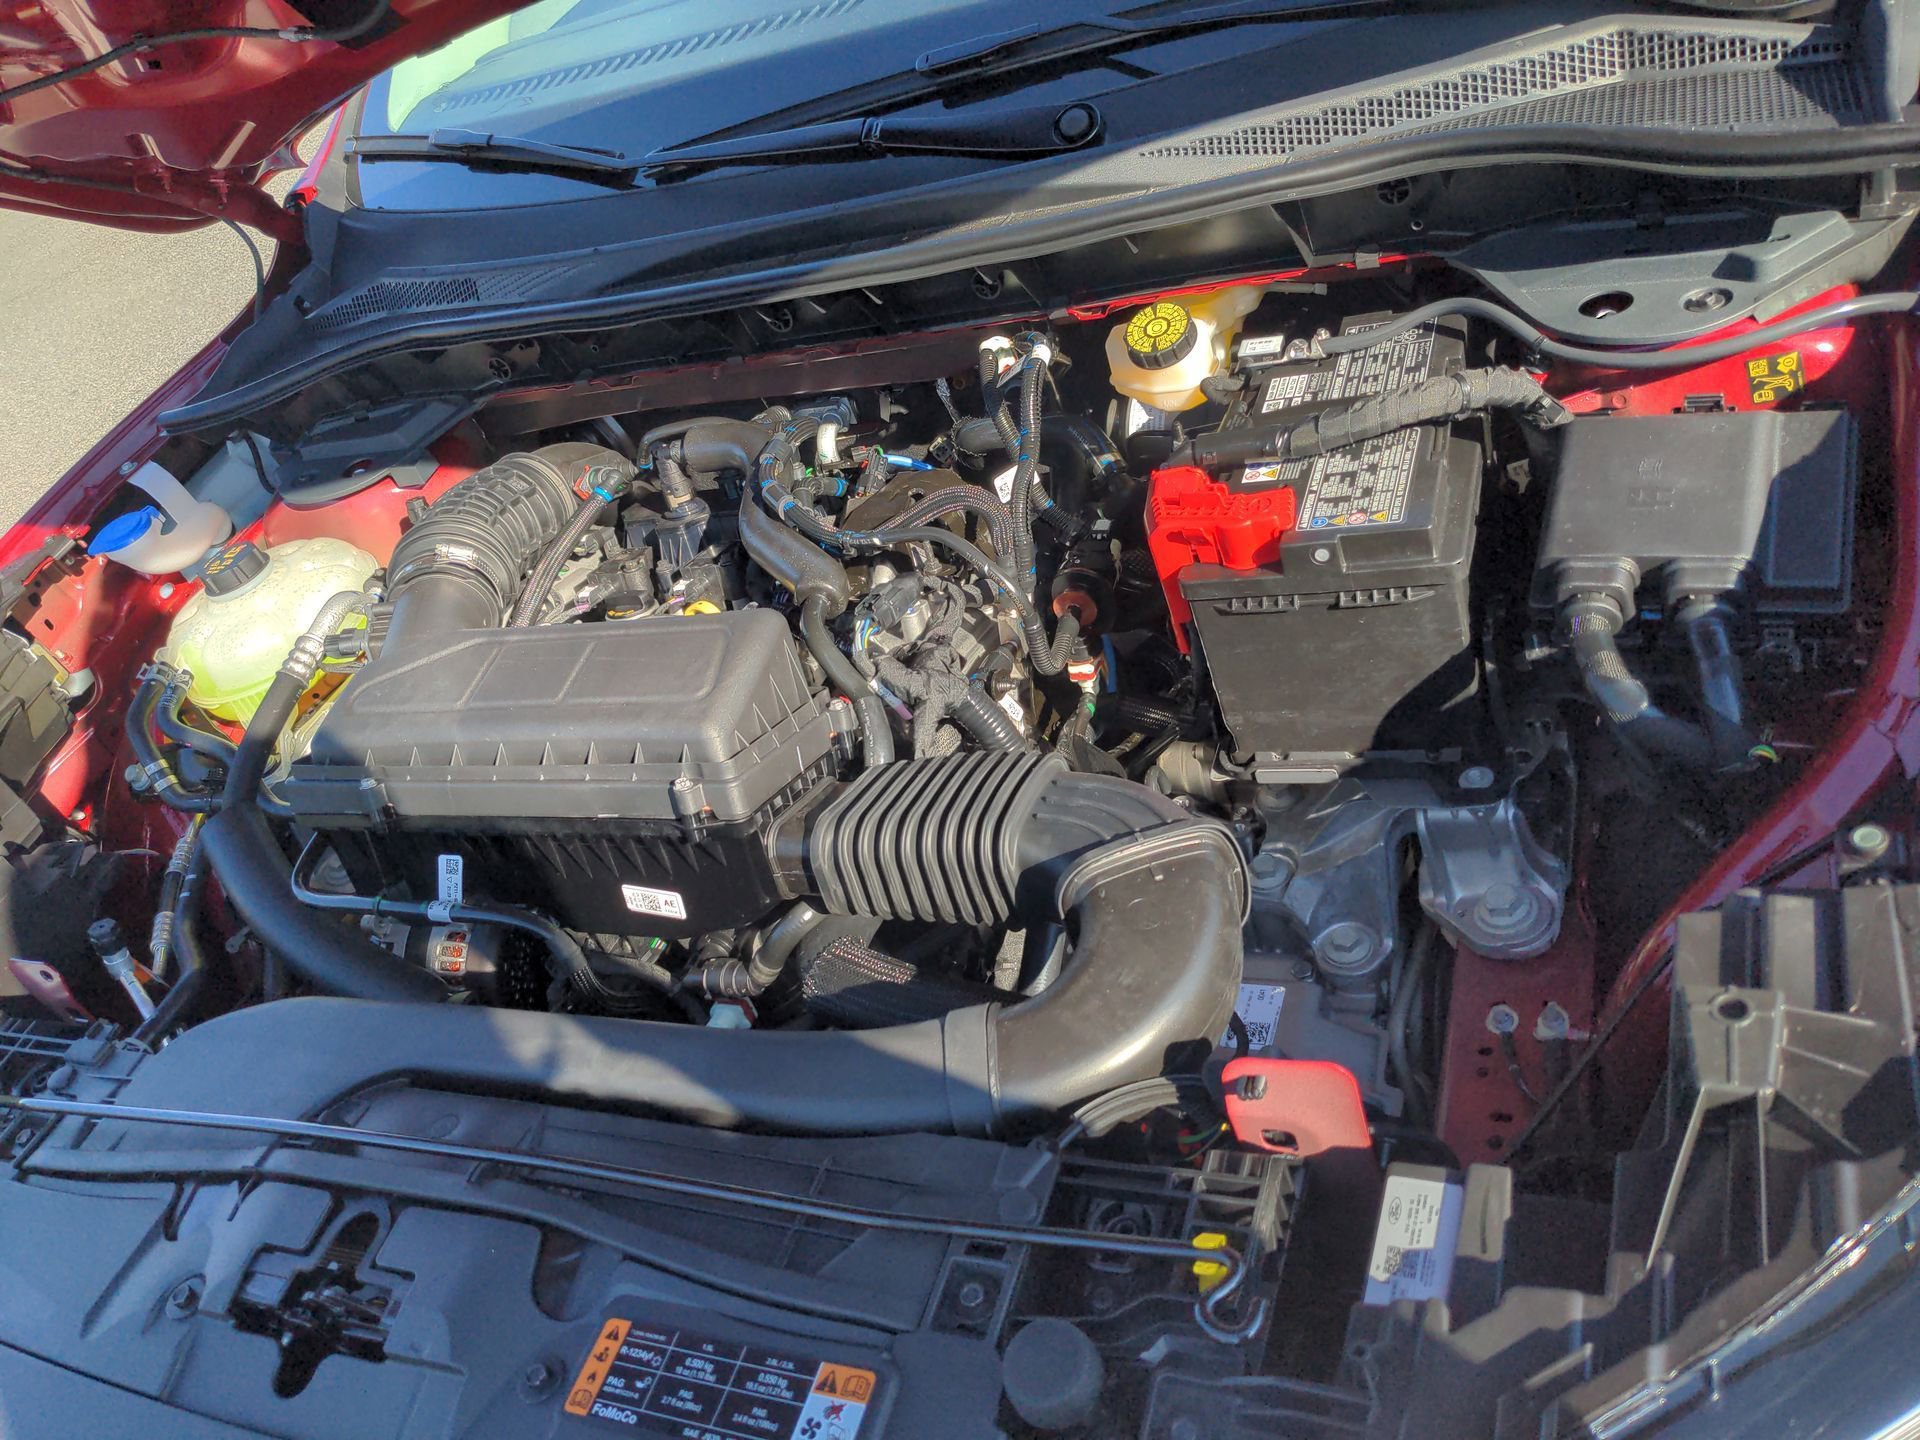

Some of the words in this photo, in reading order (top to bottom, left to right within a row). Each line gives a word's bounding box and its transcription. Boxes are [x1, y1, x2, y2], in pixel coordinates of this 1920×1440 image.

[664, 899, 677, 908] AE
[620, 1346, 654, 1362] R-1234yf
[606, 1376, 626, 1388] PAG
[592, 1402, 638, 1424] FoMoCo
